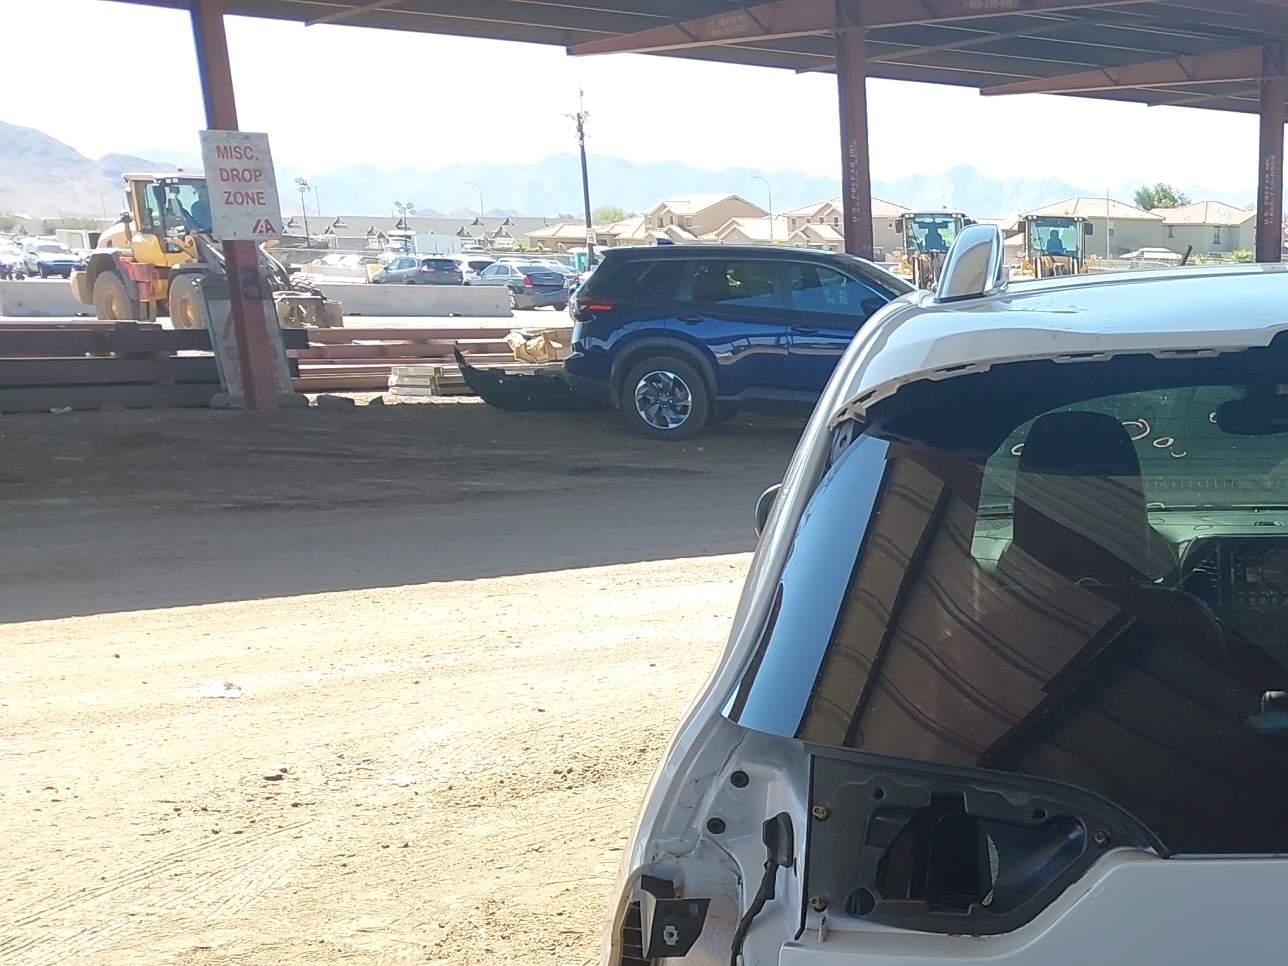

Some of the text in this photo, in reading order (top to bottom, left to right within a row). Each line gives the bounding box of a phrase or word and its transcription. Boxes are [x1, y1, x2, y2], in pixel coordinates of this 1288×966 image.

[216, 145, 259, 160] MISC.
[219, 168, 262, 182] DROP
[223, 191, 266, 206] ZONE
